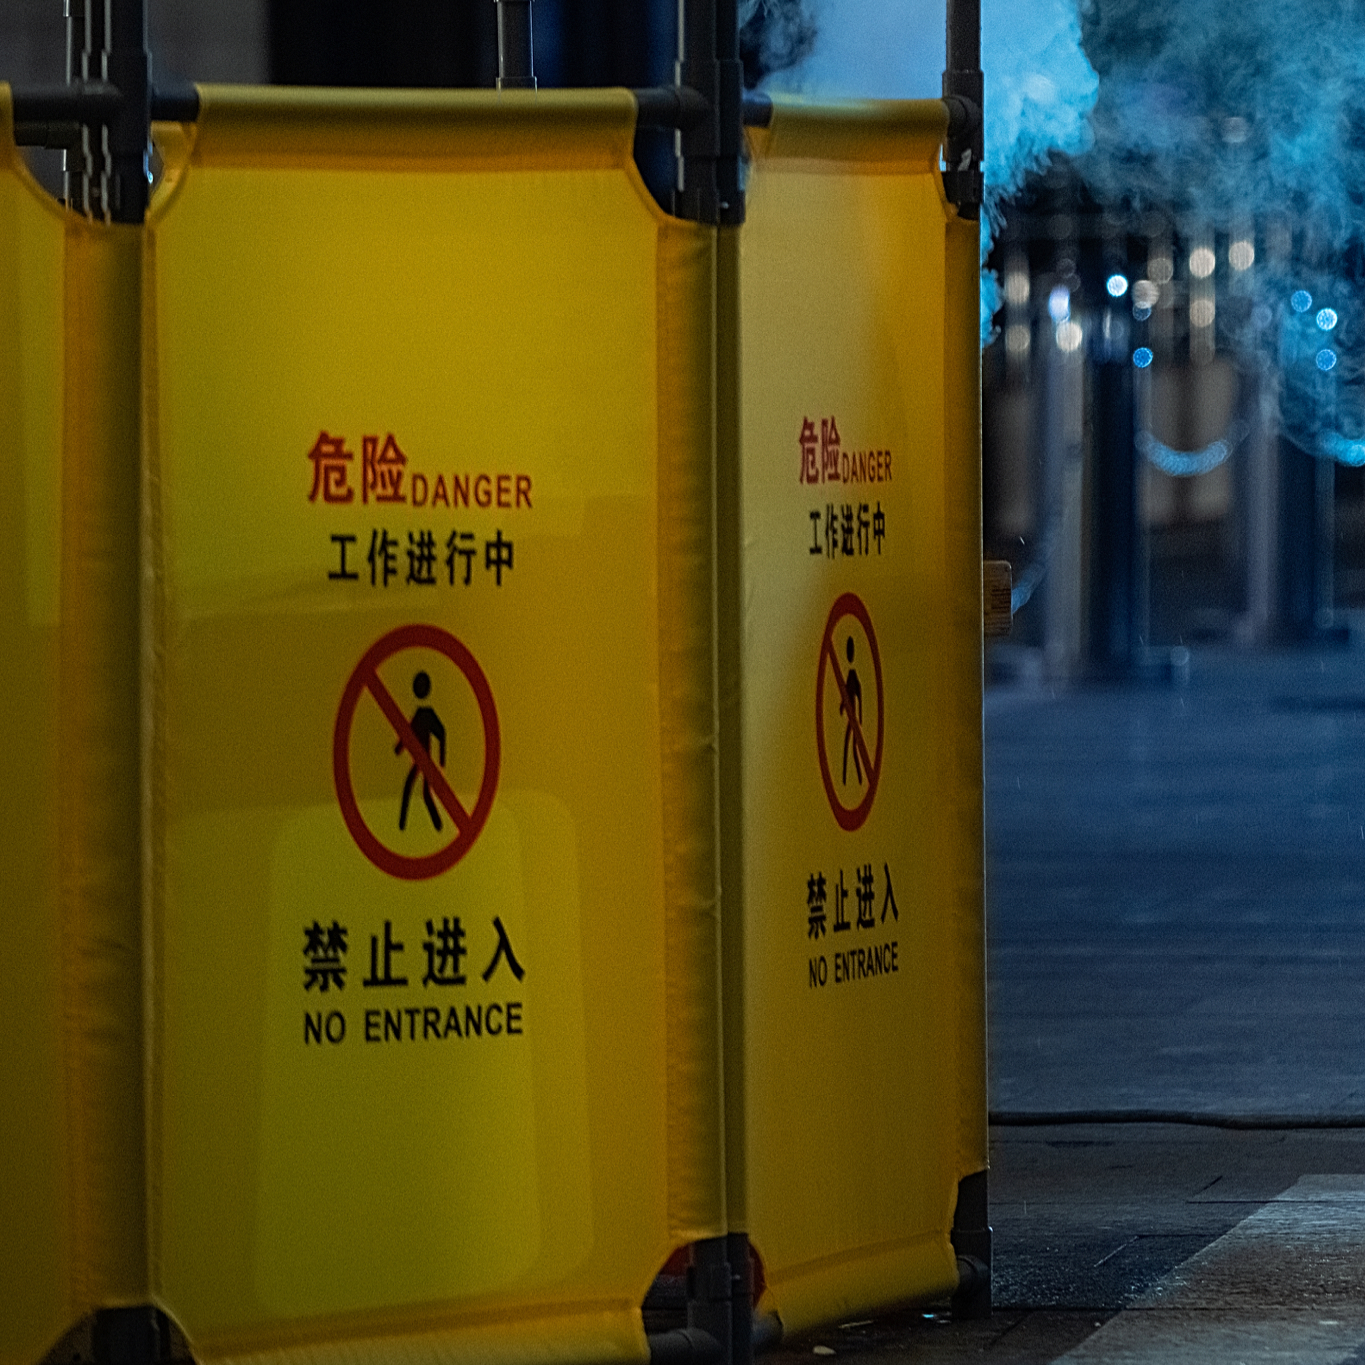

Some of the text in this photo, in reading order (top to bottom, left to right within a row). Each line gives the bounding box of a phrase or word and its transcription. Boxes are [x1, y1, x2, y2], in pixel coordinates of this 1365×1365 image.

[305, 429, 532, 508] 危险 DANGER
[798, 415, 891, 484] 危险 DANGER
[326, 527, 513, 588] 工作进行中
[809, 501, 885, 558] 工作进行中
[807, 863, 898, 940] 禁止进入
[301, 915, 524, 992] 禁止进入
[807, 941, 899, 987] NO ENTRANCE
[303, 1001, 523, 1044] NO ENTRANCE
